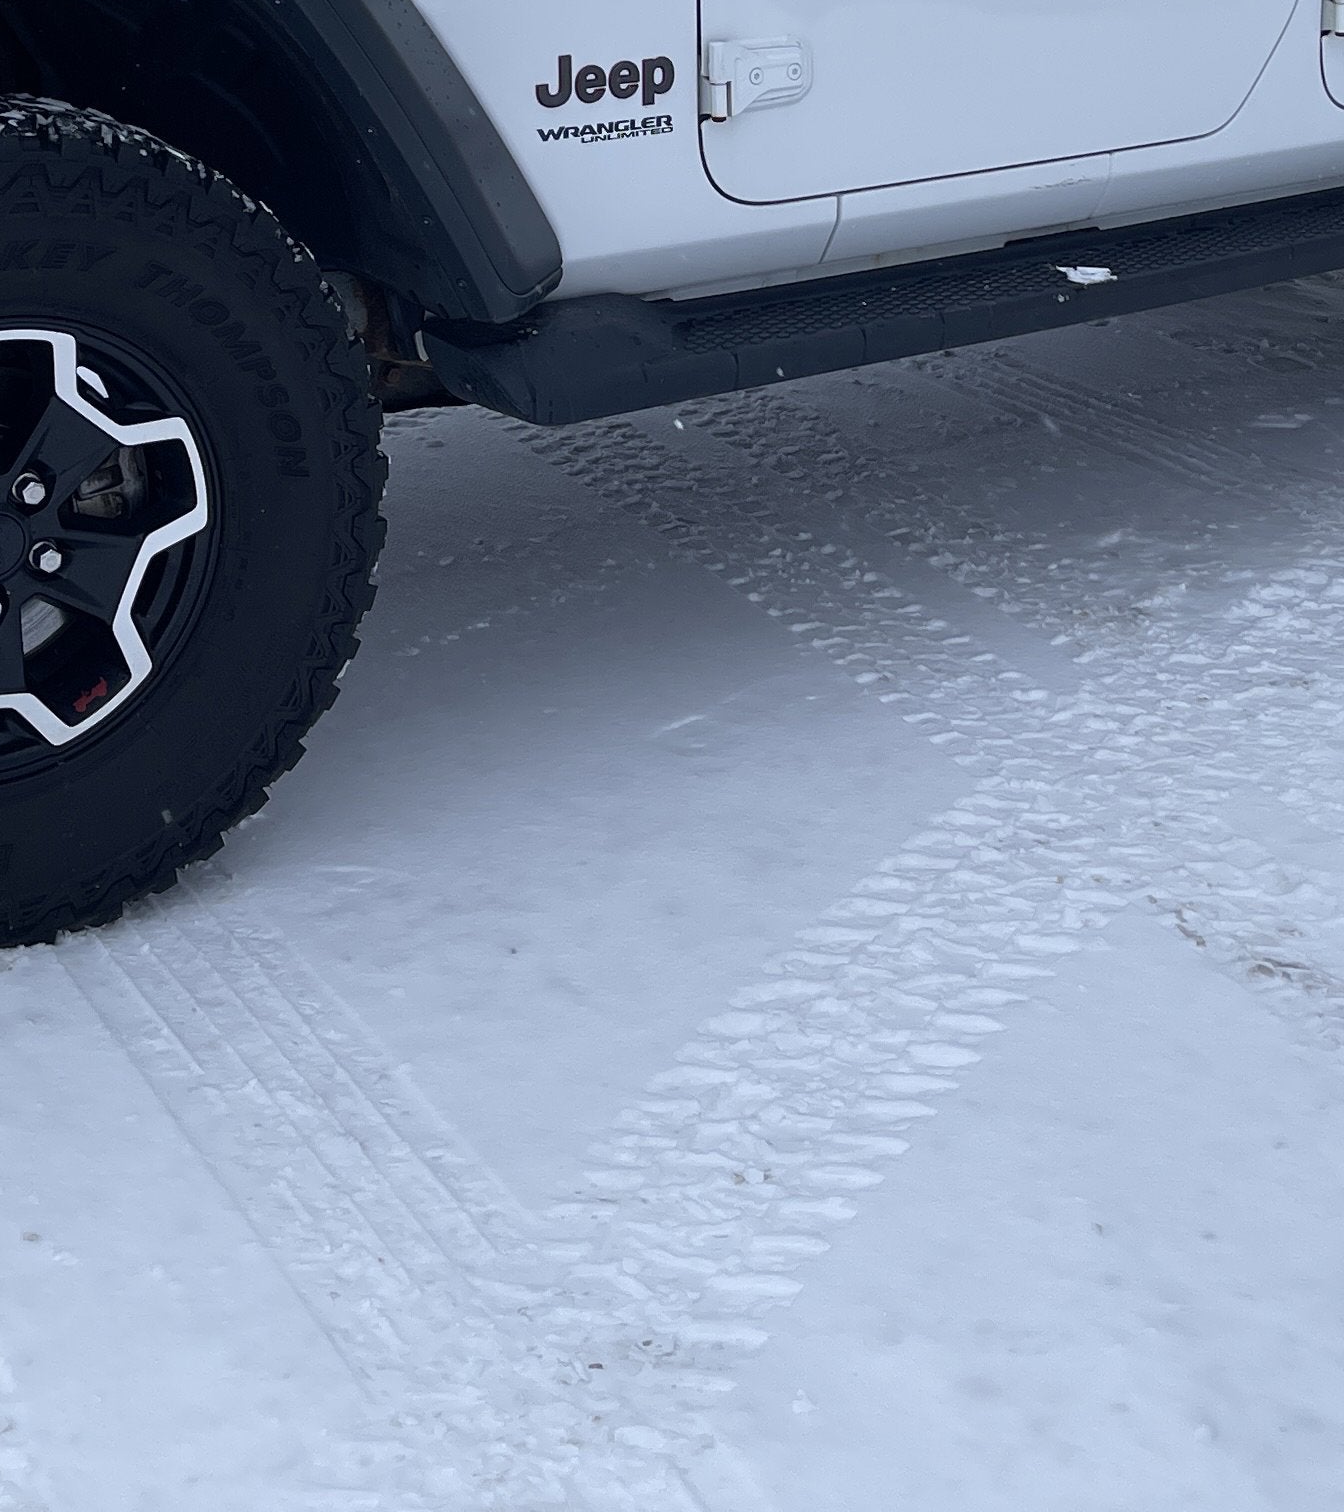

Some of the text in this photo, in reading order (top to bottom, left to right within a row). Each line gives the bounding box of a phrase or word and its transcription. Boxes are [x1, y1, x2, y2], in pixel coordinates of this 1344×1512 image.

[535, 54, 675, 108] Jeep
[537, 114, 673, 142] WRANGLER
[581, 126, 674, 144] UNLIMITED
[132, 261, 311, 479] THOMPSON
